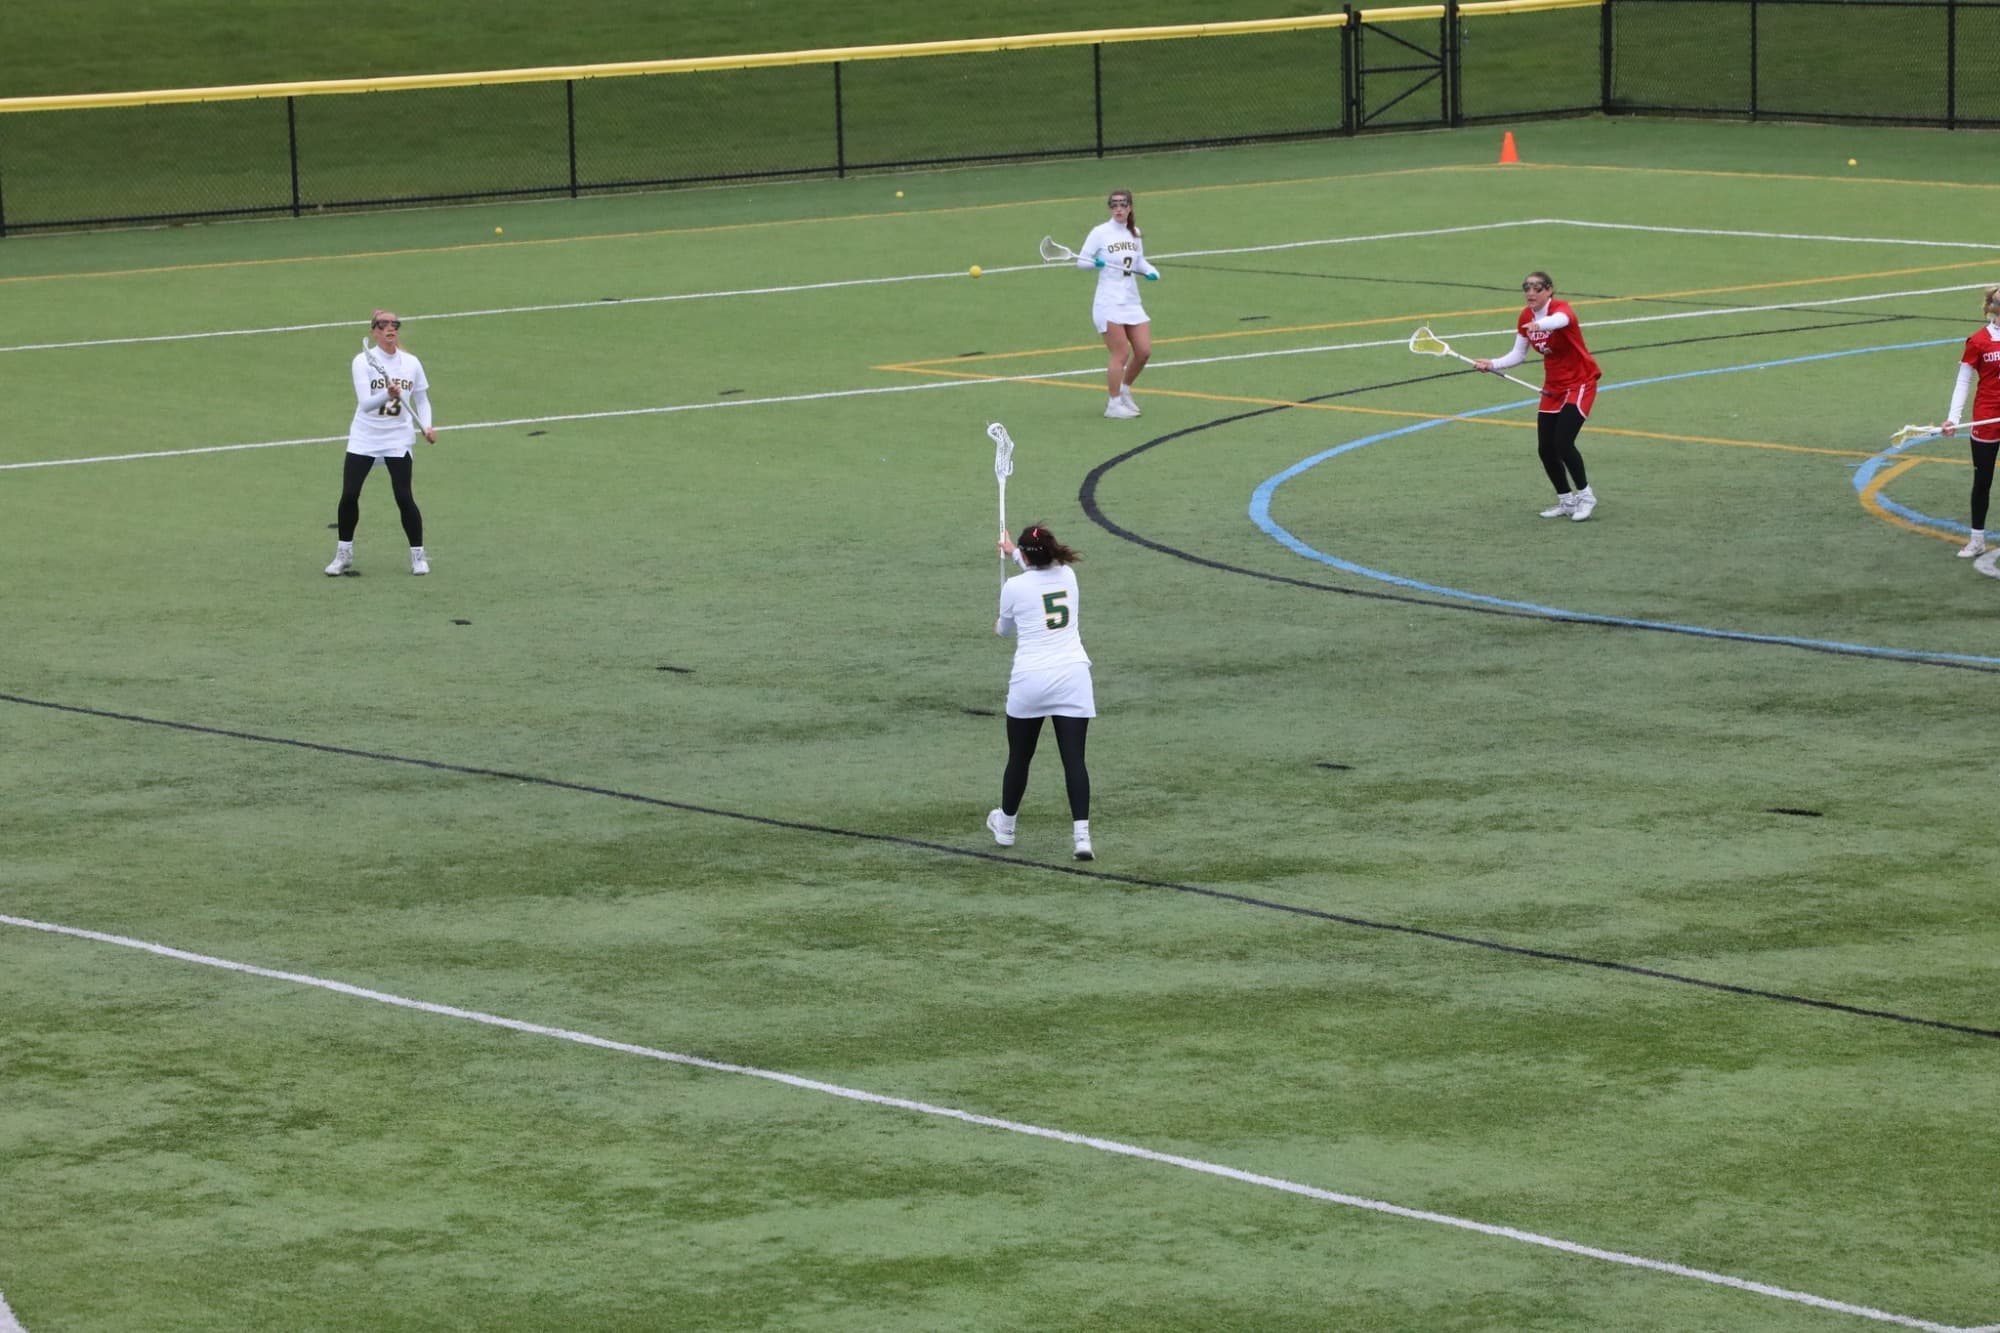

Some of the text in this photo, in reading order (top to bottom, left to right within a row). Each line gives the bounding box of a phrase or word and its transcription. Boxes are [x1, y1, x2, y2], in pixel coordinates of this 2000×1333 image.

[1122, 256, 1133, 277] 2
[378, 397, 402, 416] 13
[1042, 590, 1069, 630] 5
